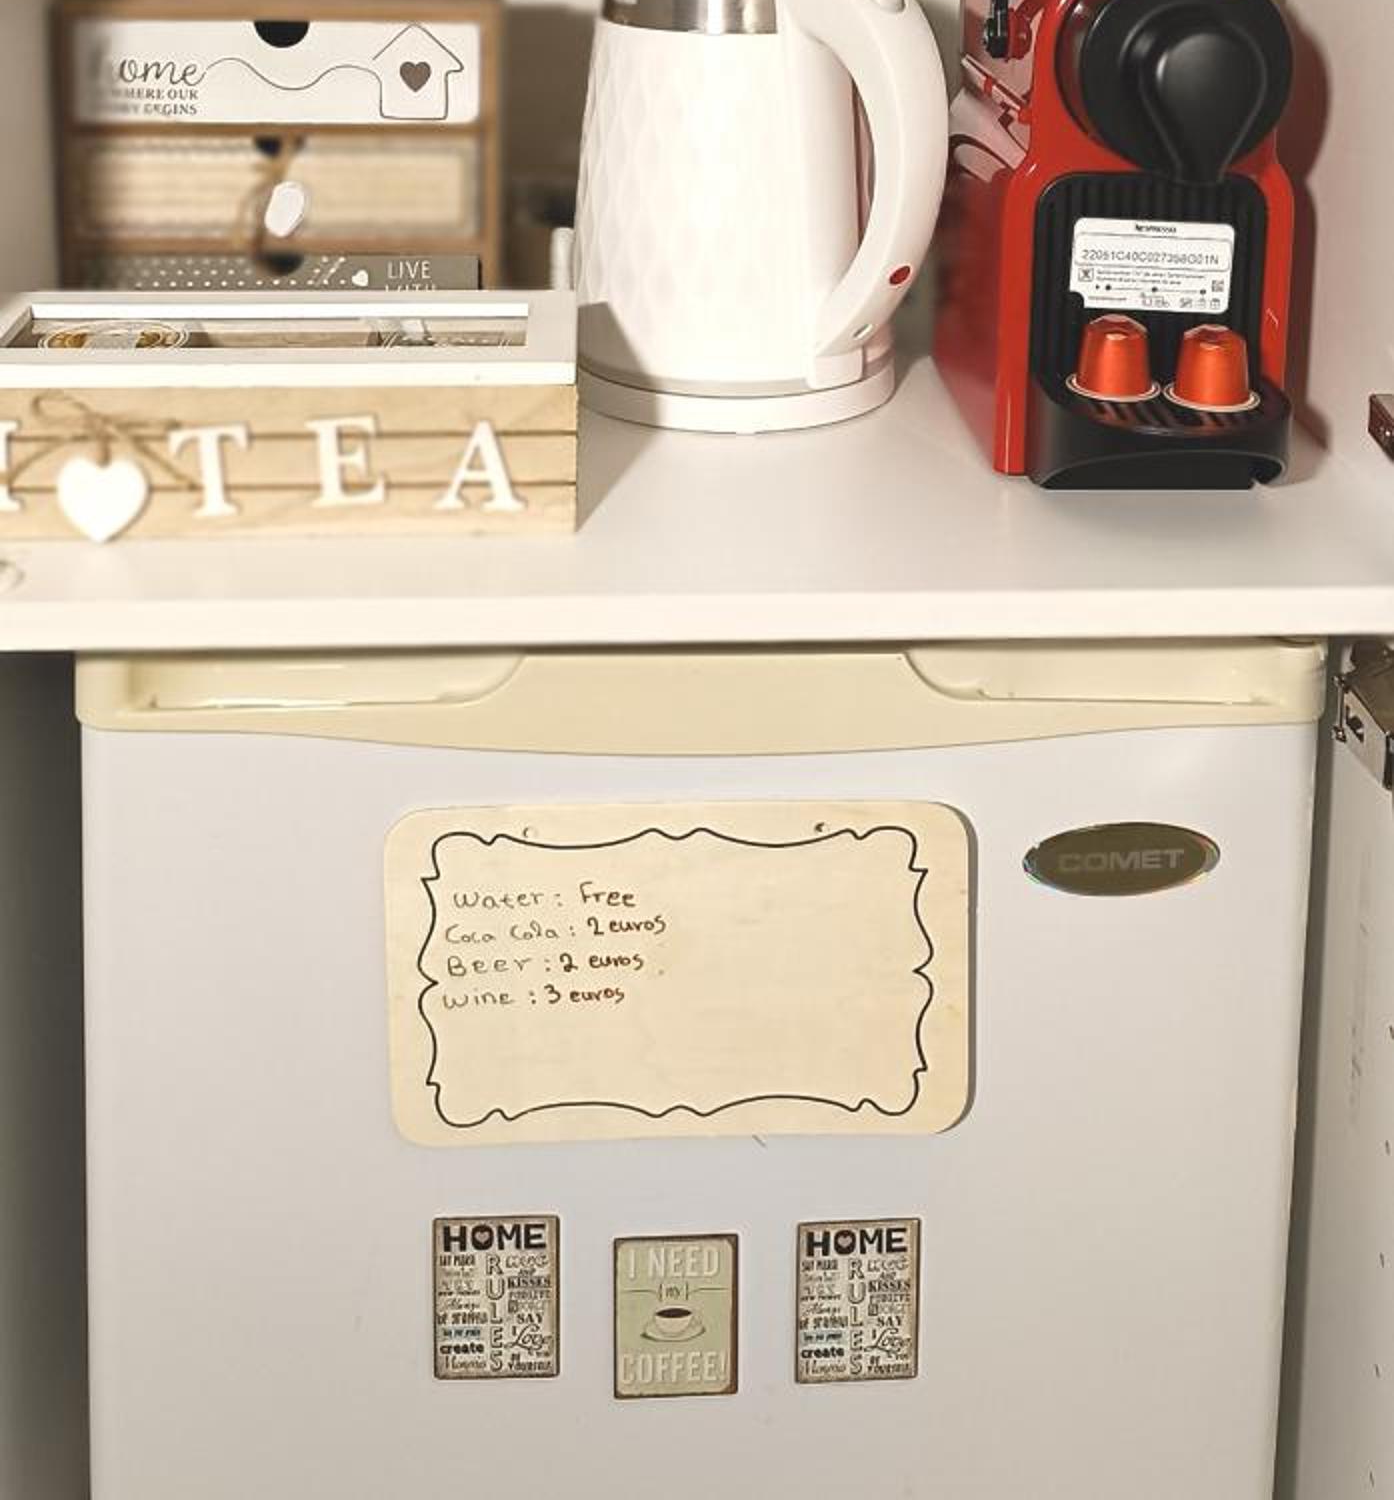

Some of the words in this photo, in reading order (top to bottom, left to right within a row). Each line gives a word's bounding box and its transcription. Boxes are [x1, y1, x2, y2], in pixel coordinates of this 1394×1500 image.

[167, 88, 199, 100] OUR
[387, 261, 431, 279] LIVE
[168, 414, 525, 518] TEA
[1058, 848, 1185, 872] COMET
[579, 881, 637, 908] Free
[608, 915, 667, 934] euros
[588, 953, 645, 972] euros
[569, 985, 626, 1004] euros
[443, 1223, 547, 1252] HOME
[806, 1228, 908, 1257] HOME
[627, 1248, 637, 1280] I
[649, 1245, 722, 1279] NEED
[485, 1254, 505, 1372] RULES
[848, 1258, 867, 1375] RULES
[439, 1342, 485, 1355] create
[801, 1346, 845, 1359] create
[621, 1350, 729, 1386] COFFEE!
